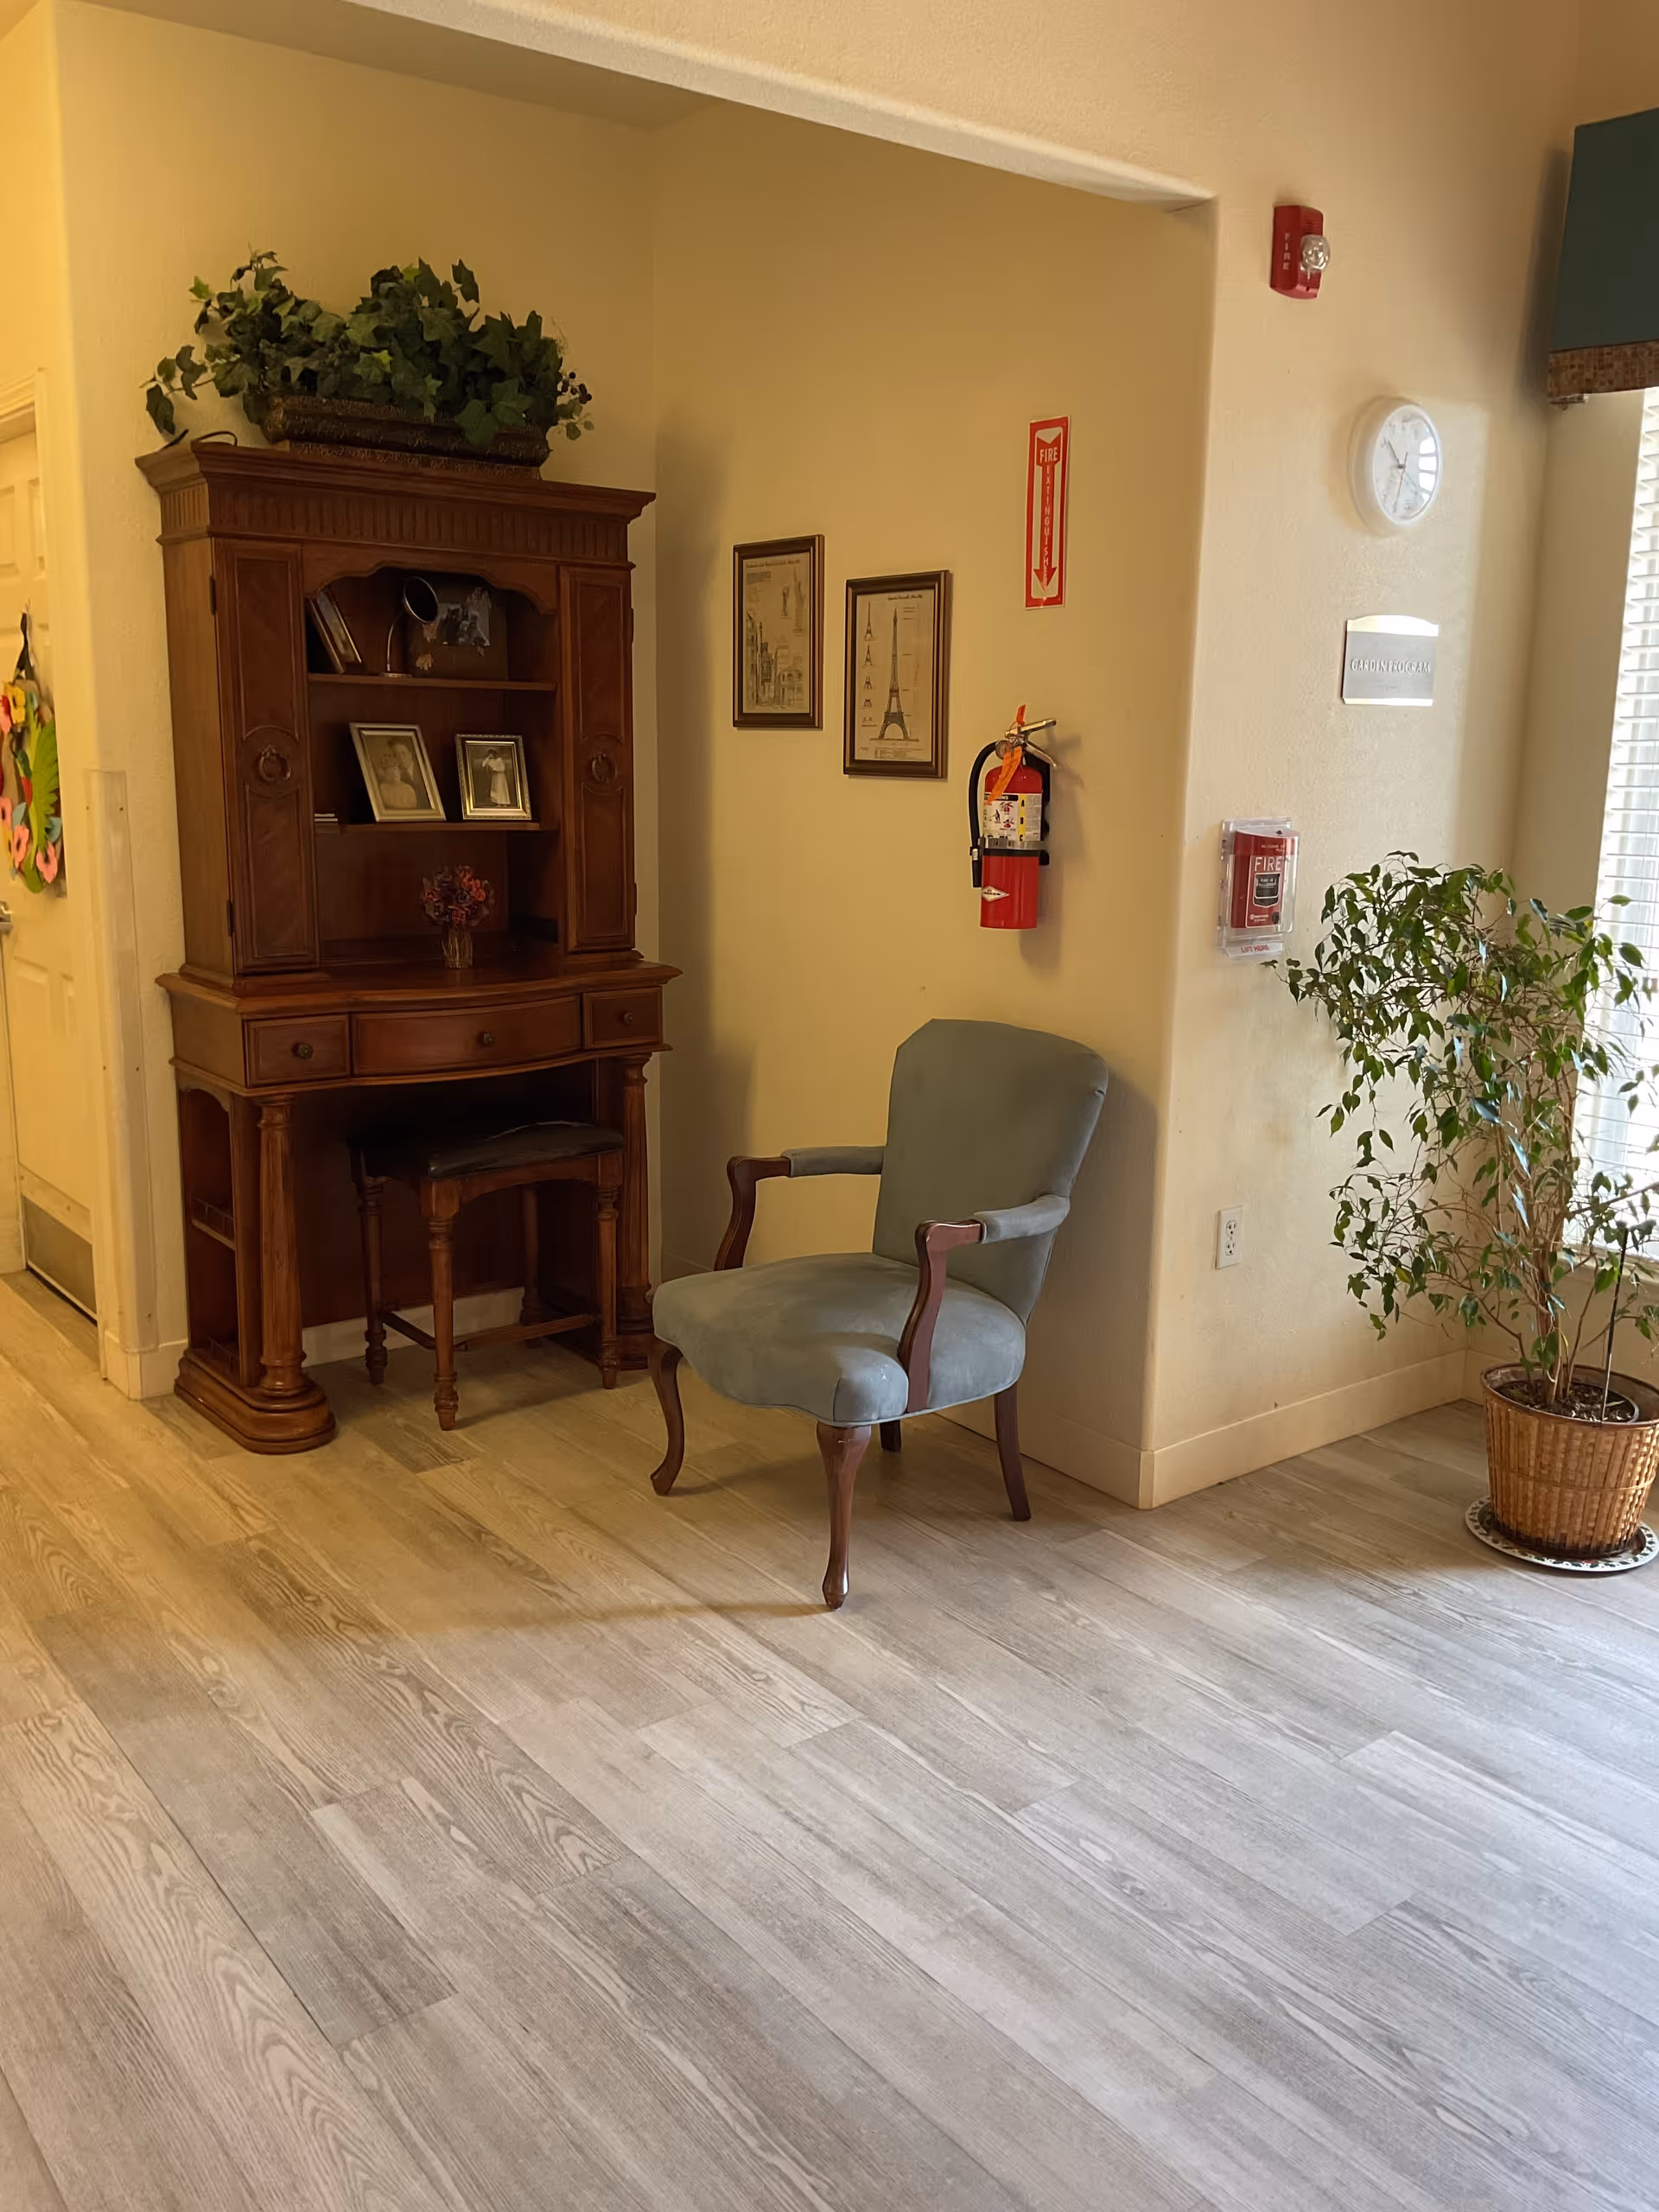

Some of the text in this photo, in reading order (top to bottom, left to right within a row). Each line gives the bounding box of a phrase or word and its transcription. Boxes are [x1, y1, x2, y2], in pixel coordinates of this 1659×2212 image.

[1039, 447, 1058, 463] FIRE
[1388, 660, 1431, 673] PROGRAM
[1254, 856, 1283, 872] FIRE
